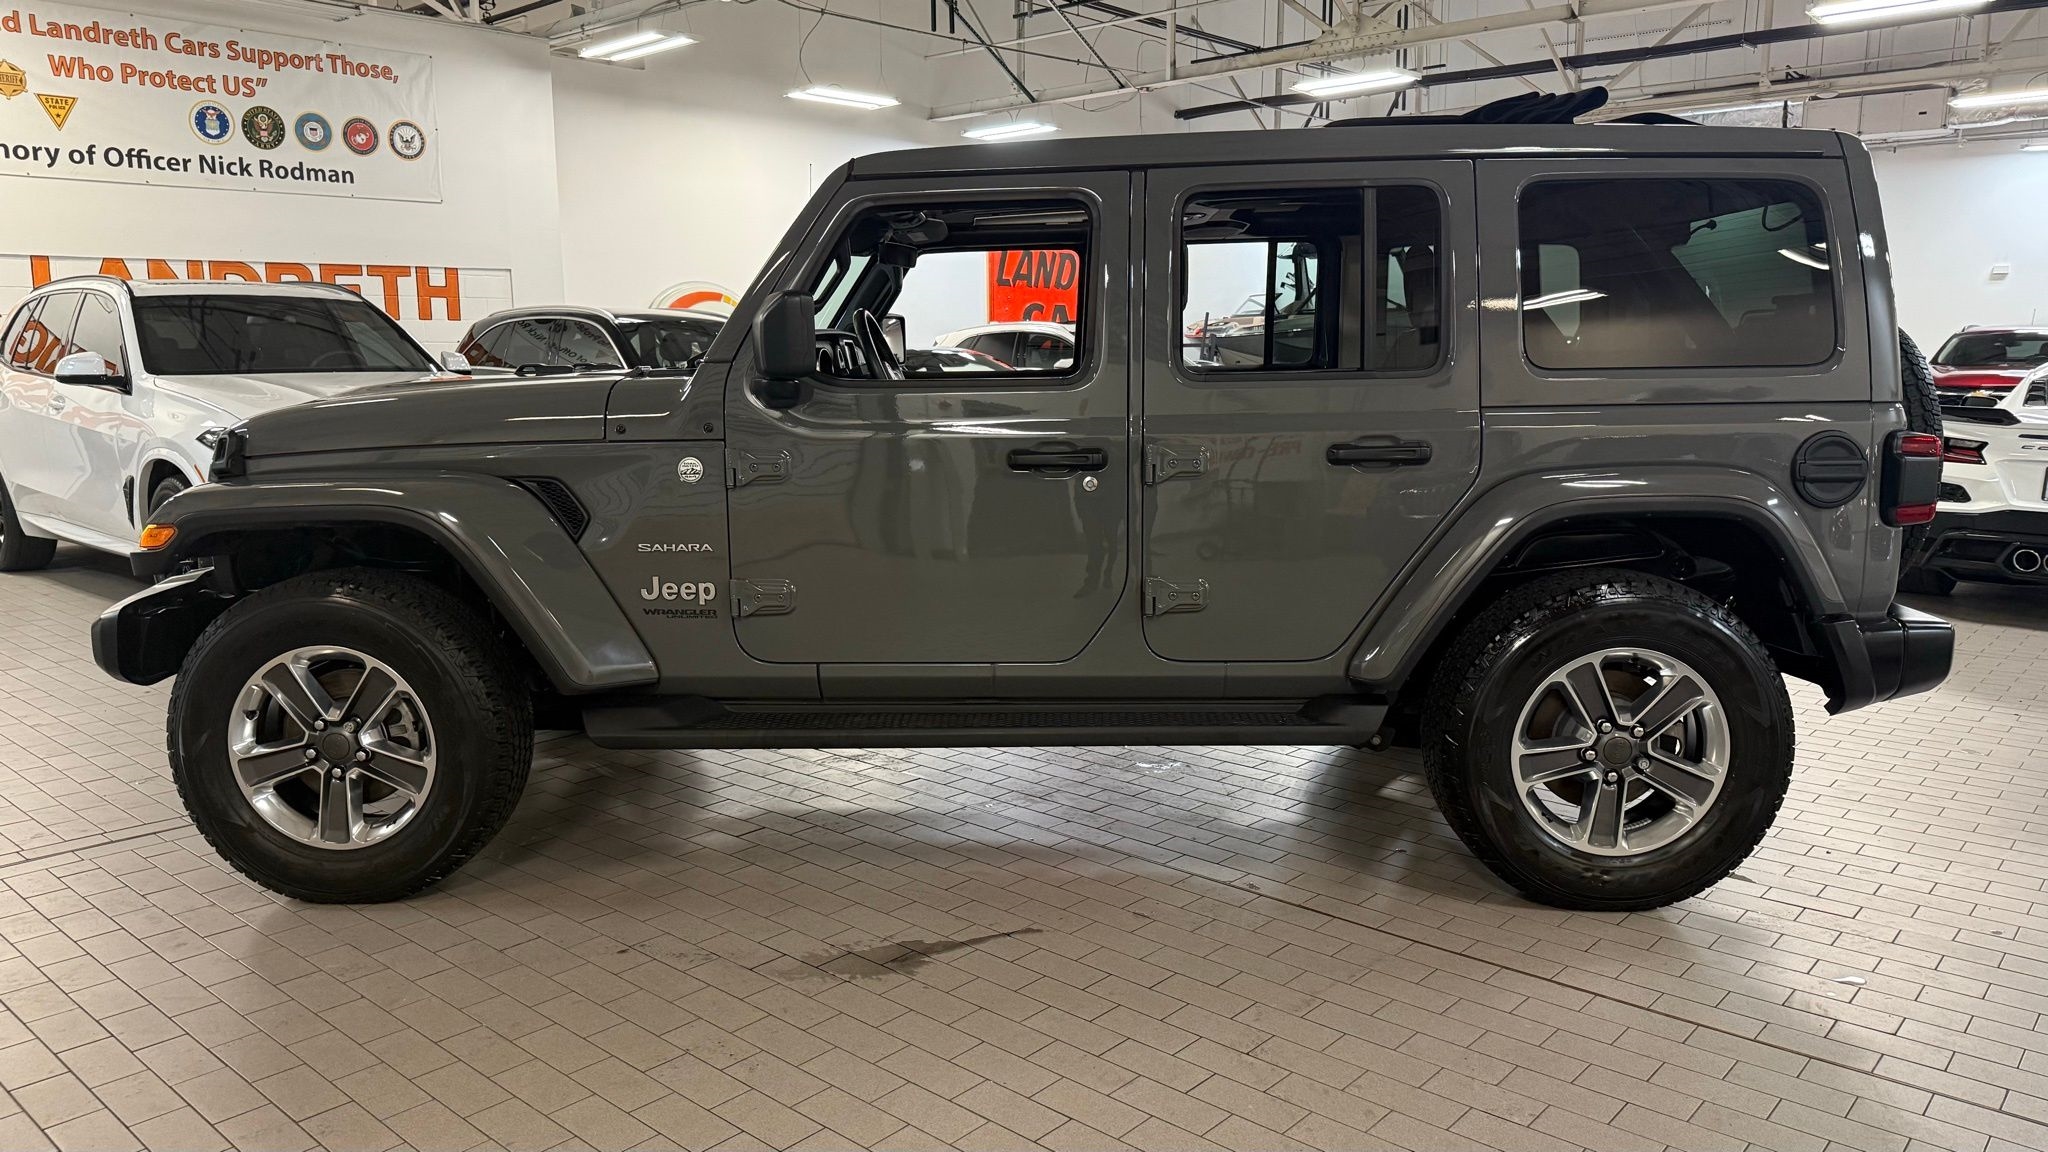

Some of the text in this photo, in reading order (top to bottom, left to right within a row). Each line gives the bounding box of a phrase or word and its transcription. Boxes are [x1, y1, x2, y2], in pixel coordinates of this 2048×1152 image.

[0, 10, 399, 84] d Landreth Cars Support Those,
[47, 54, 114, 82] Who
[120, 62, 217, 94] Protect
[45, 97, 69, 105] STATE
[68, 144, 96, 165] of
[103, 146, 191, 172] Officer
[199, 154, 253, 177] Nick
[259, 159, 355, 184] Rodman
[638, 543, 713, 552] SAHARA
[640, 576, 716, 605] Jeep
[643, 608, 718, 616] WRANGLER
